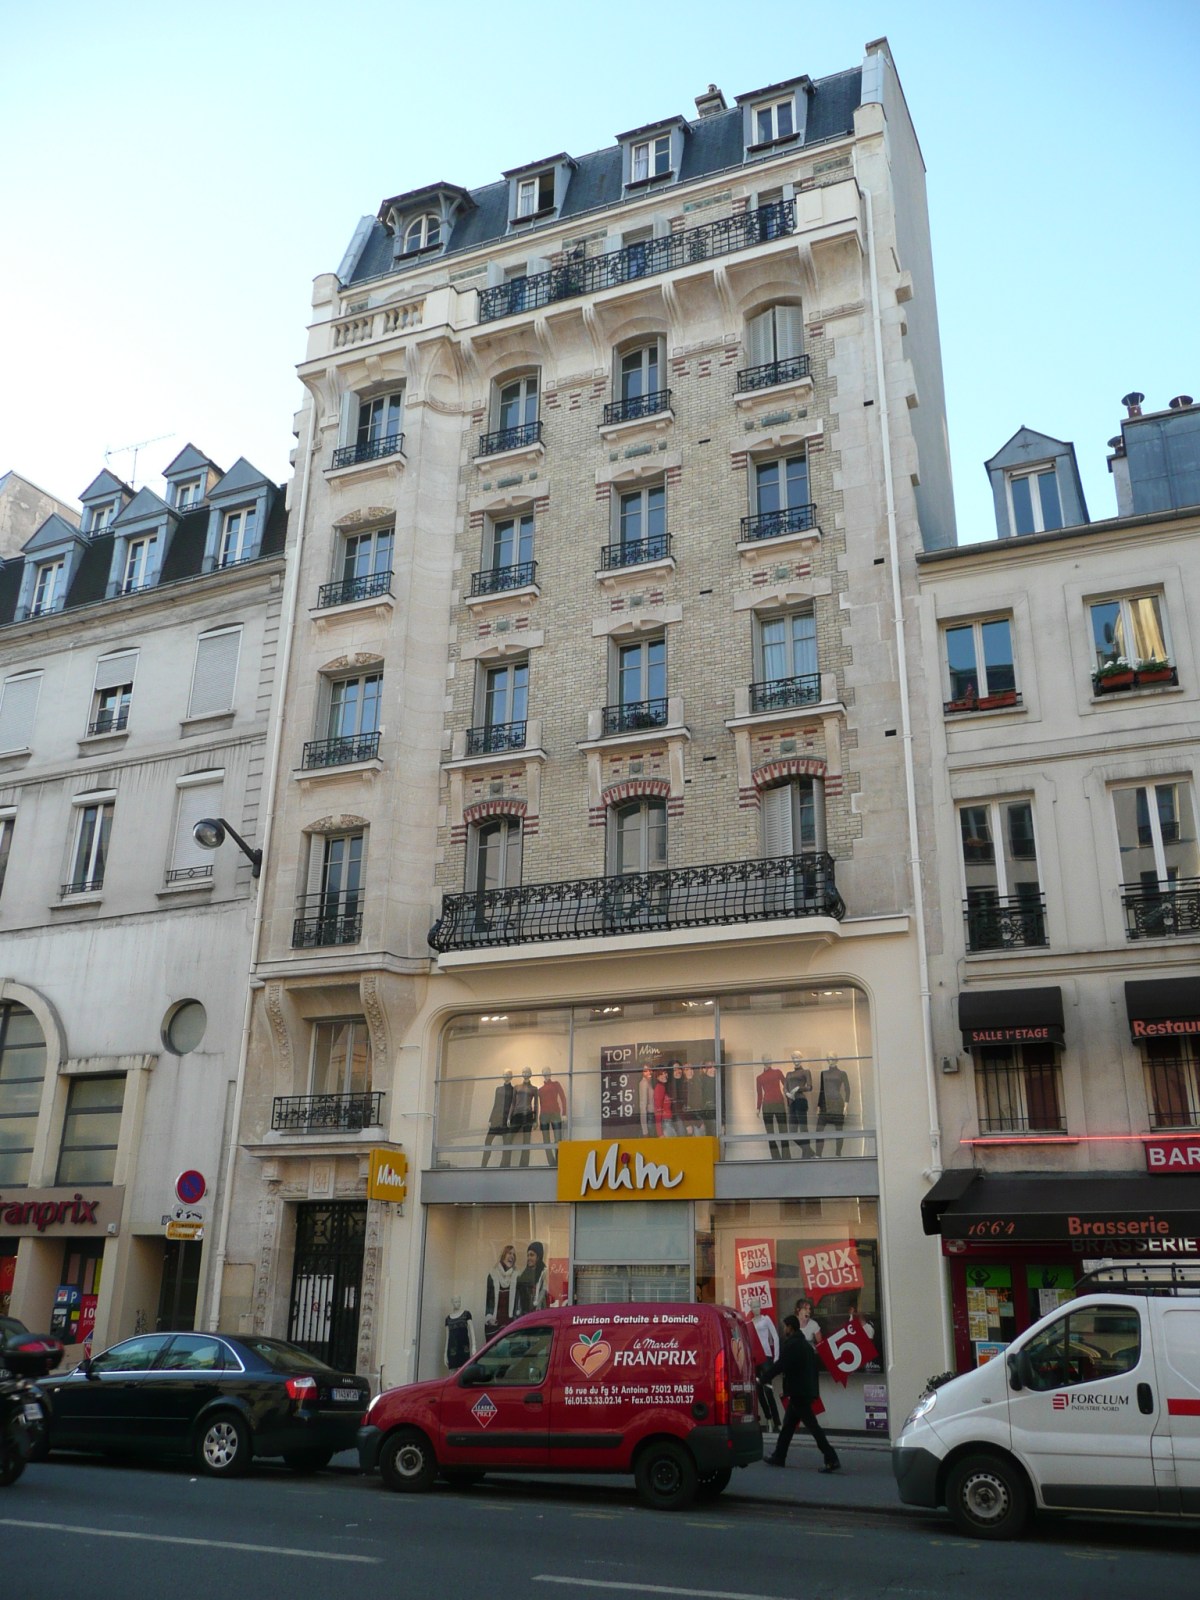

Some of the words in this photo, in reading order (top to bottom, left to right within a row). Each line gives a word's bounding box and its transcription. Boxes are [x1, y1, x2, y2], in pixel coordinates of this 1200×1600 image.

[972, 1031, 1002, 1041] SALLE
[1015, 1028, 1048, 1039] ETAGE
[1133, 1020, 1200, 1036] Restau
[604, 1049, 631, 1062] TOP
[639, 1045, 661, 1056] Mim
[1149, 1147, 1200, 1166] BAR
[377, 1163, 405, 1187] Mim
[581, 1143, 683, 1196] Mim
[0, 1193, 100, 1232] ranprix
[967, 1219, 1015, 1236] 1664
[1067, 1216, 1169, 1236] Brasserie
[1072, 1238, 1197, 1251] BRASSERIE
[741, 1248, 766, 1261] PRIX
[803, 1248, 854, 1274] PRIX
[743, 1258, 769, 1270] FOUS!
[807, 1266, 859, 1291] FOUS!
[741, 1285, 767, 1298] PRIX
[573, 1316, 610, 1324] Livraison
[613, 1315, 649, 1324] Gratuite
[653, 1315, 659, 1324] à
[662, 1315, 699, 1324] Domicile
[643, 1338, 679, 1349] Marché
[613, 1350, 697, 1366] FRANPRIX
[565, 1386, 573, 1395] 86
[575, 1387, 588, 1395] rue
[589, 1386, 598, 1395] du
[600, 1385, 609, 1396] Fg
[611, 1385, 619, 1394] St
[621, 1385, 648, 1394] Antoine
[651, 1385, 671, 1393] 75012
[673, 1384, 694, 1393] PARIS
[1071, 1394, 1129, 1405] FORCLUM
